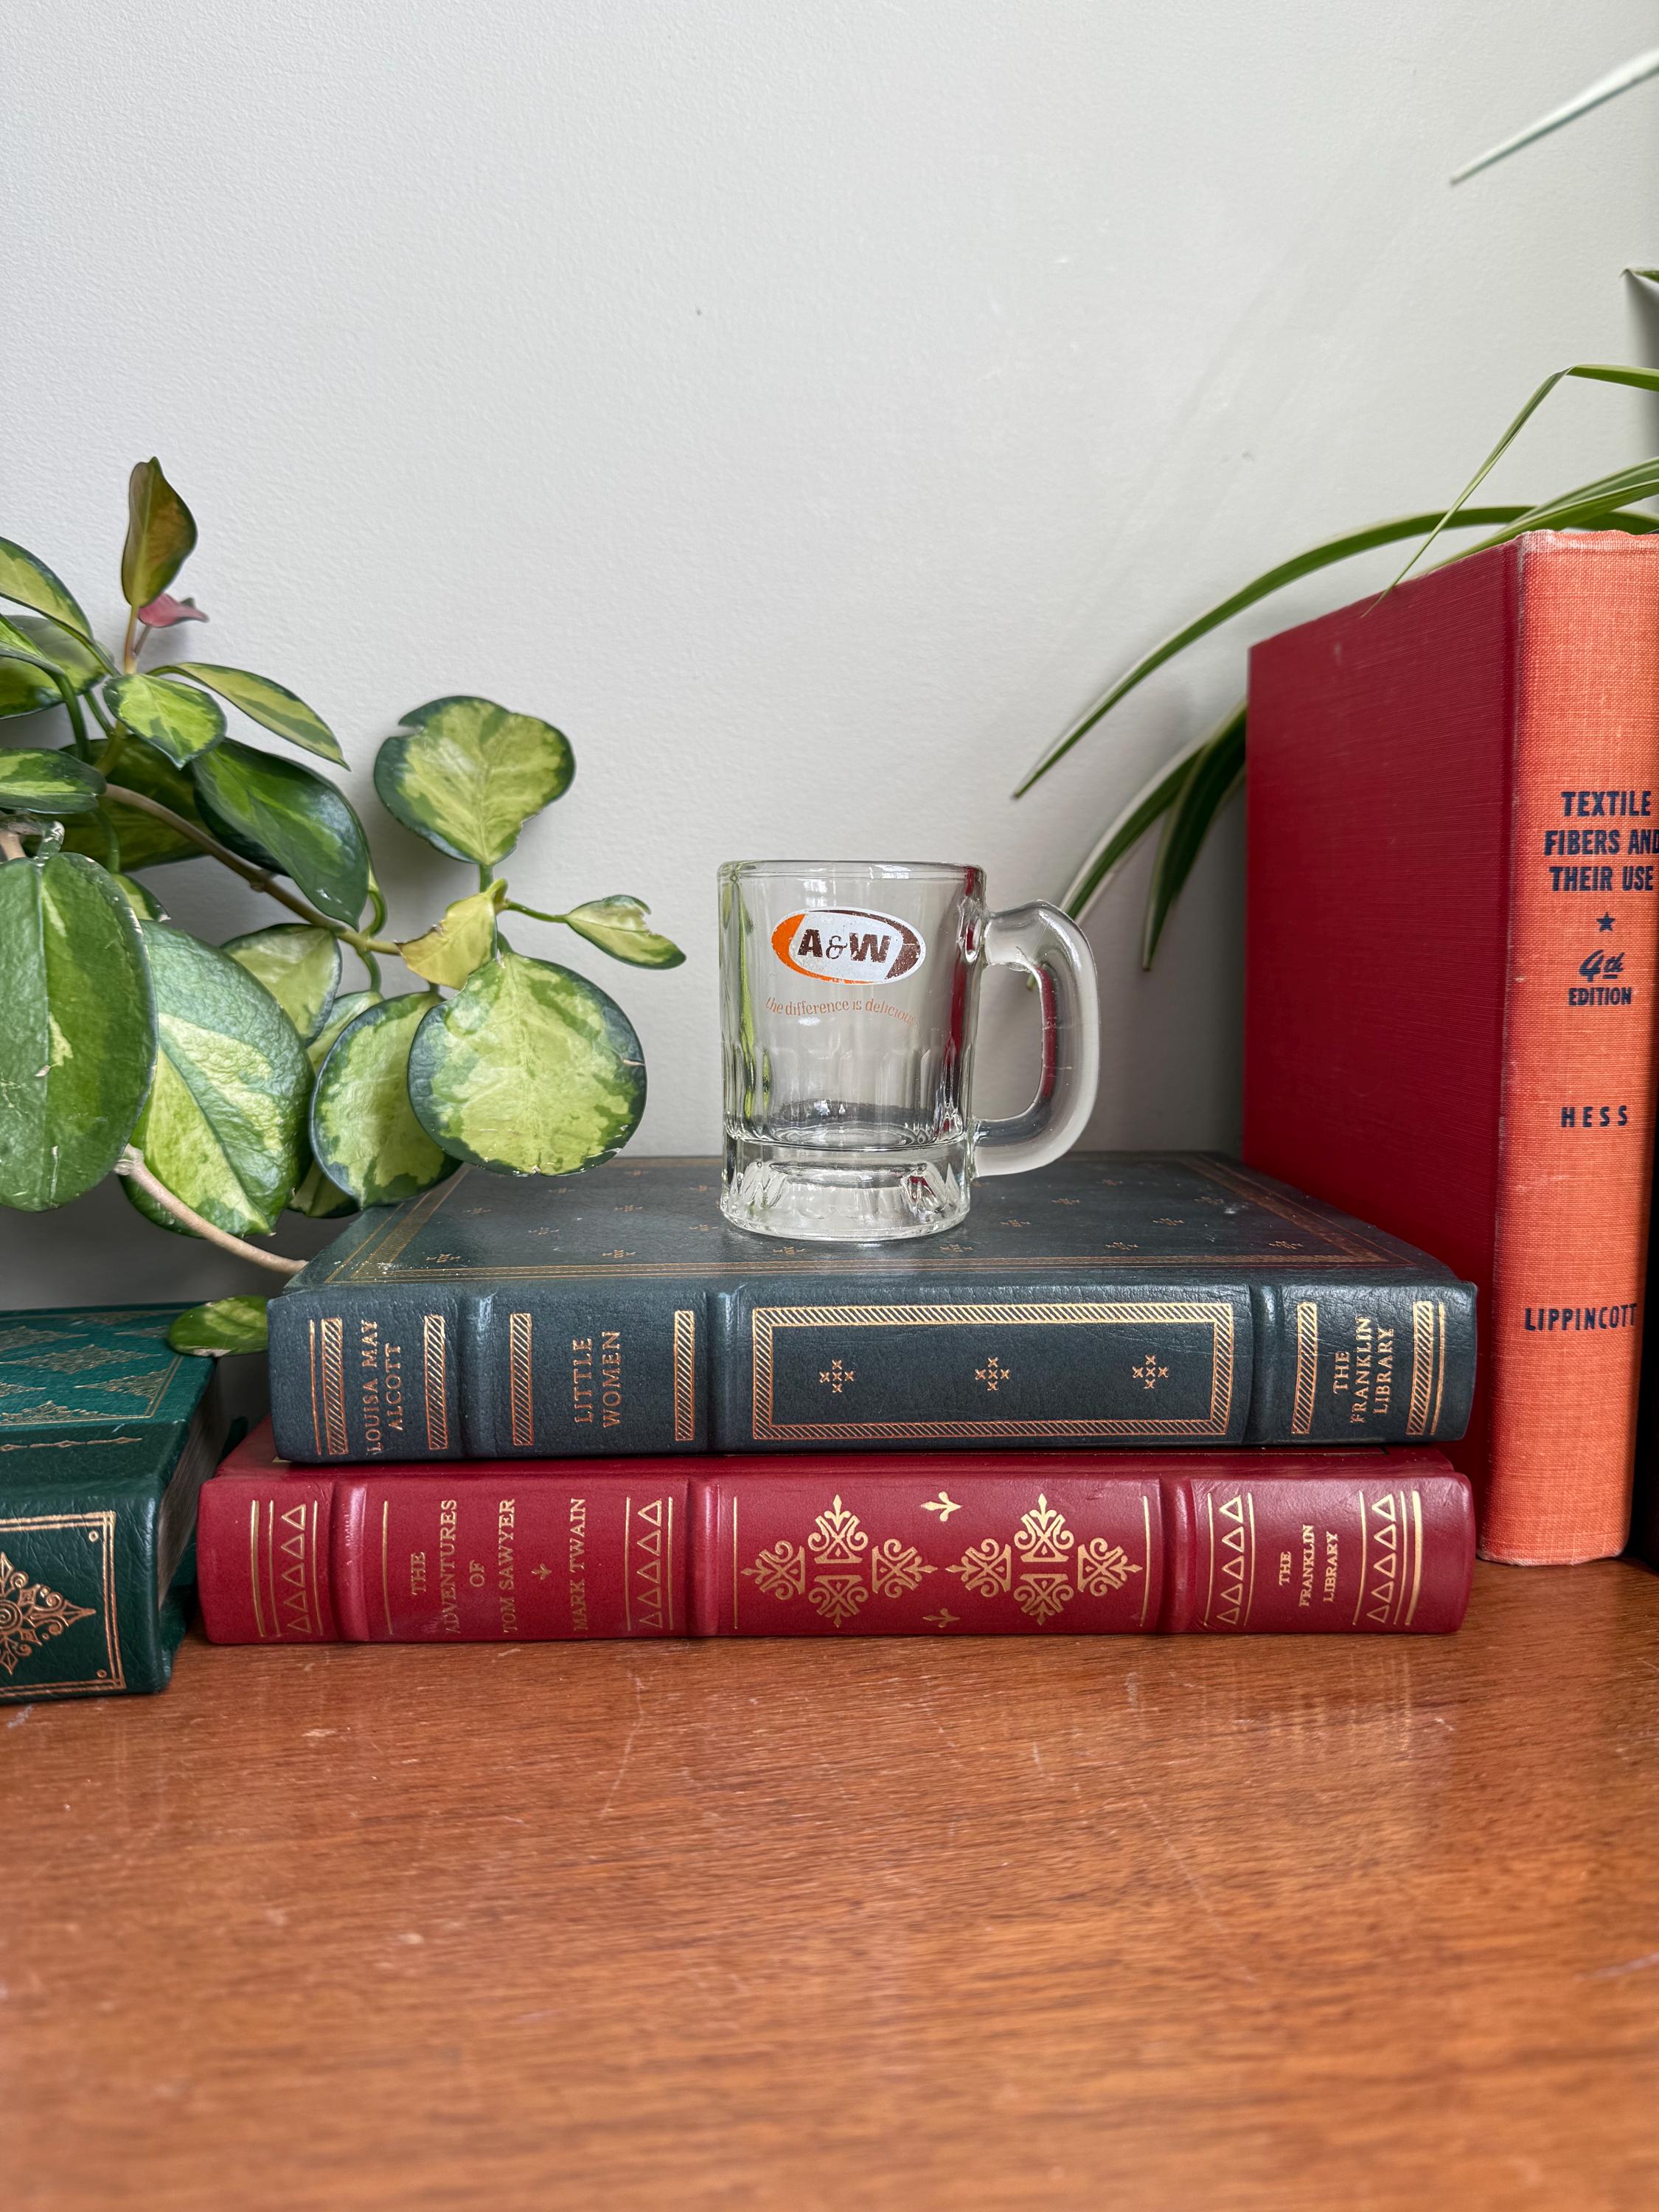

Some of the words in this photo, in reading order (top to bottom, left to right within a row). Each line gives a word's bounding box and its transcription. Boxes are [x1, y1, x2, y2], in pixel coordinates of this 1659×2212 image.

[1561, 790, 1651, 817] TEXTILE
[1544, 829, 1621, 856] FIBERS
[1627, 829, 1659, 854] AND
[1549, 866, 1613, 891] THEIR
[1621, 865, 1654, 891] USE
[798, 928, 891, 963] A&W
[1579, 950, 1624, 983] 4th
[766, 997, 783, 1014] the
[785, 999, 849, 1016] difference
[852, 999, 862, 1010] is
[1568, 987, 1632, 1006] EDITION
[1561, 1105, 1628, 1127] HESS
[1525, 1303, 1637, 1331] LIPPINCOTT
[361, 1319, 378, 1368] MAY
[385, 1343, 404, 1432] ALCOTT
[573, 1338, 593, 1424] LITTLE
[602, 1331, 622, 1428] WOMEN
[1332, 1351, 1351, 1395] THE
[1351, 1316, 1372, 1424] FRANKLIN
[1373, 1327, 1394, 1415] LIBRARY
[363, 1377, 382, 1453] LOUISA
[498, 1498, 515, 1591] SAWYER
[569, 1498, 586, 1573] TWAIN
[410, 1551, 427, 1596] THE
[439, 1499, 460, 1634] ADVENTURES
[469, 1559, 484, 1587] OF
[1279, 1551, 1292, 1586] THE
[1298, 1523, 1315, 1607] FRANKLIN
[1323, 1531, 1339, 1603] LIBRARY
[498, 1596, 518, 1633] TOM
[570, 1579, 588, 1632] MARK
